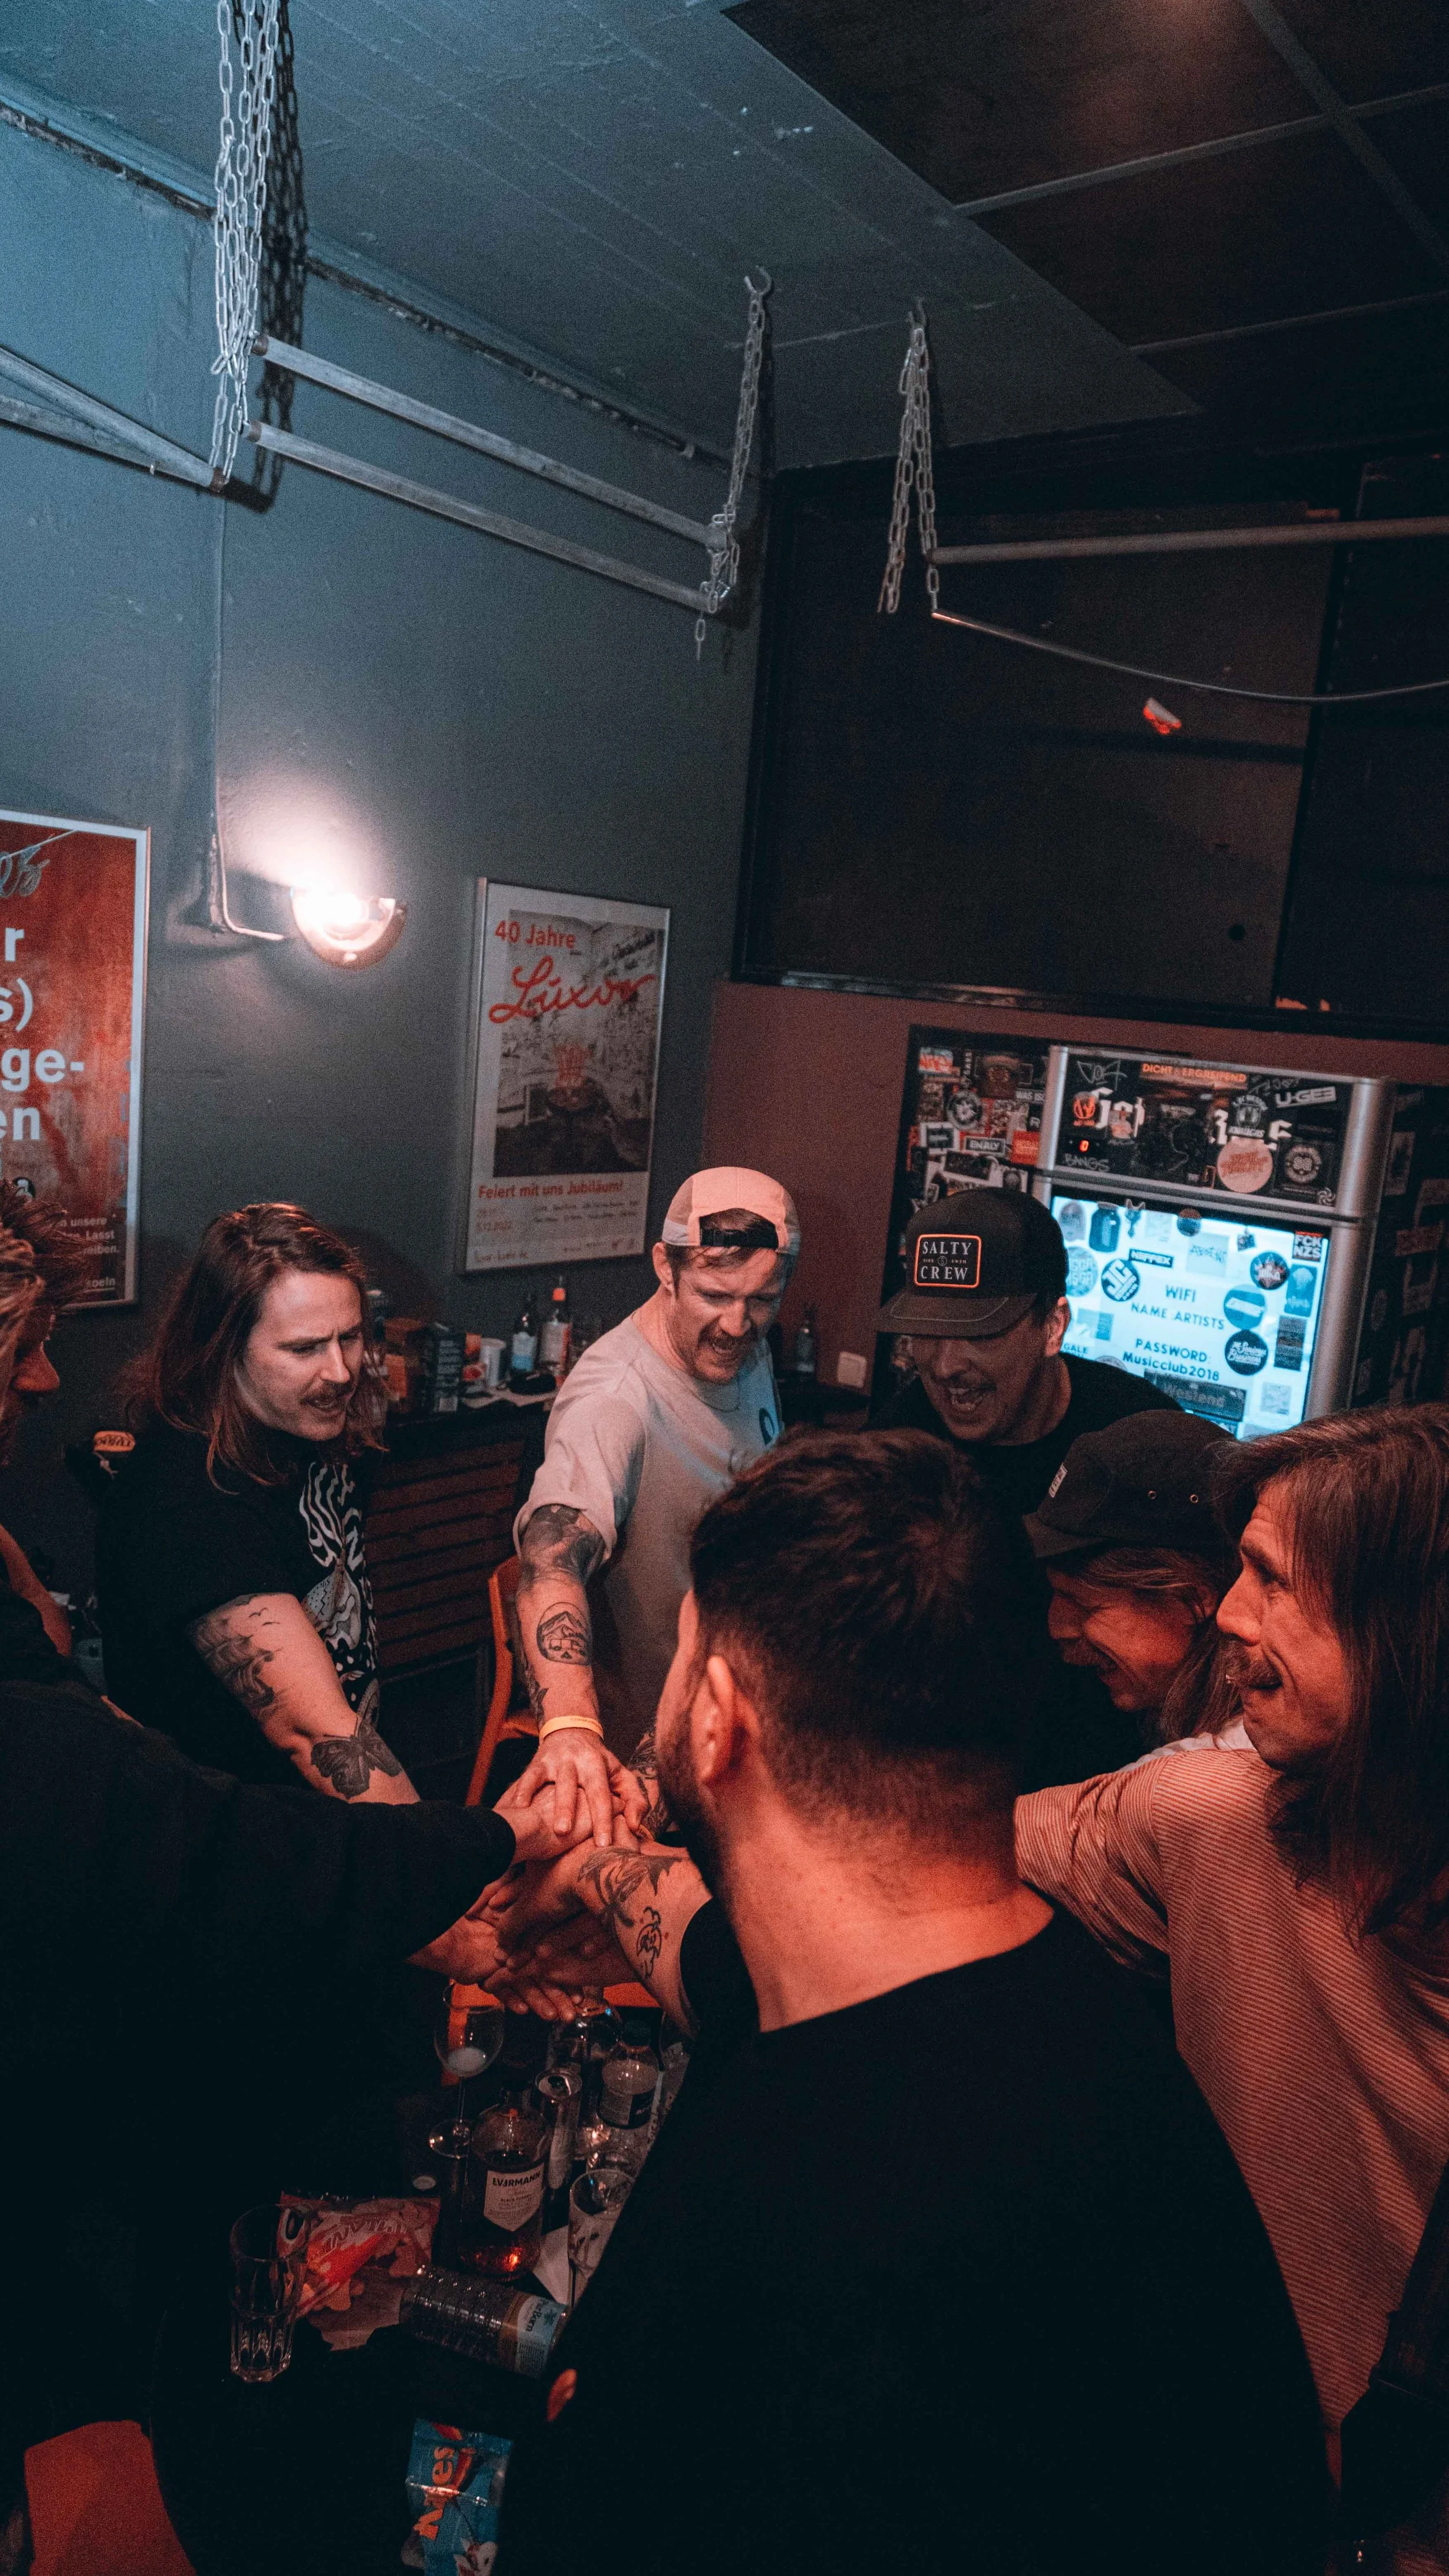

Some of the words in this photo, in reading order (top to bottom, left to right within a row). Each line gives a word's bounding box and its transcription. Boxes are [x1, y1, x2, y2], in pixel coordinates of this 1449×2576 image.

[494, 920, 521, 943] 40
[526, 924, 576, 949] Jahre
[478, 1184, 516, 1199] Feiert
[519, 1183, 540, 1197] mit
[1295, 1234, 1323, 1246] FCK
[922, 1241, 972, 1255] SALTY
[1293, 1246, 1321, 1258] NZS
[920, 1266, 969, 1280] CREW
[1166, 1285, 1196, 1303] WIFI
